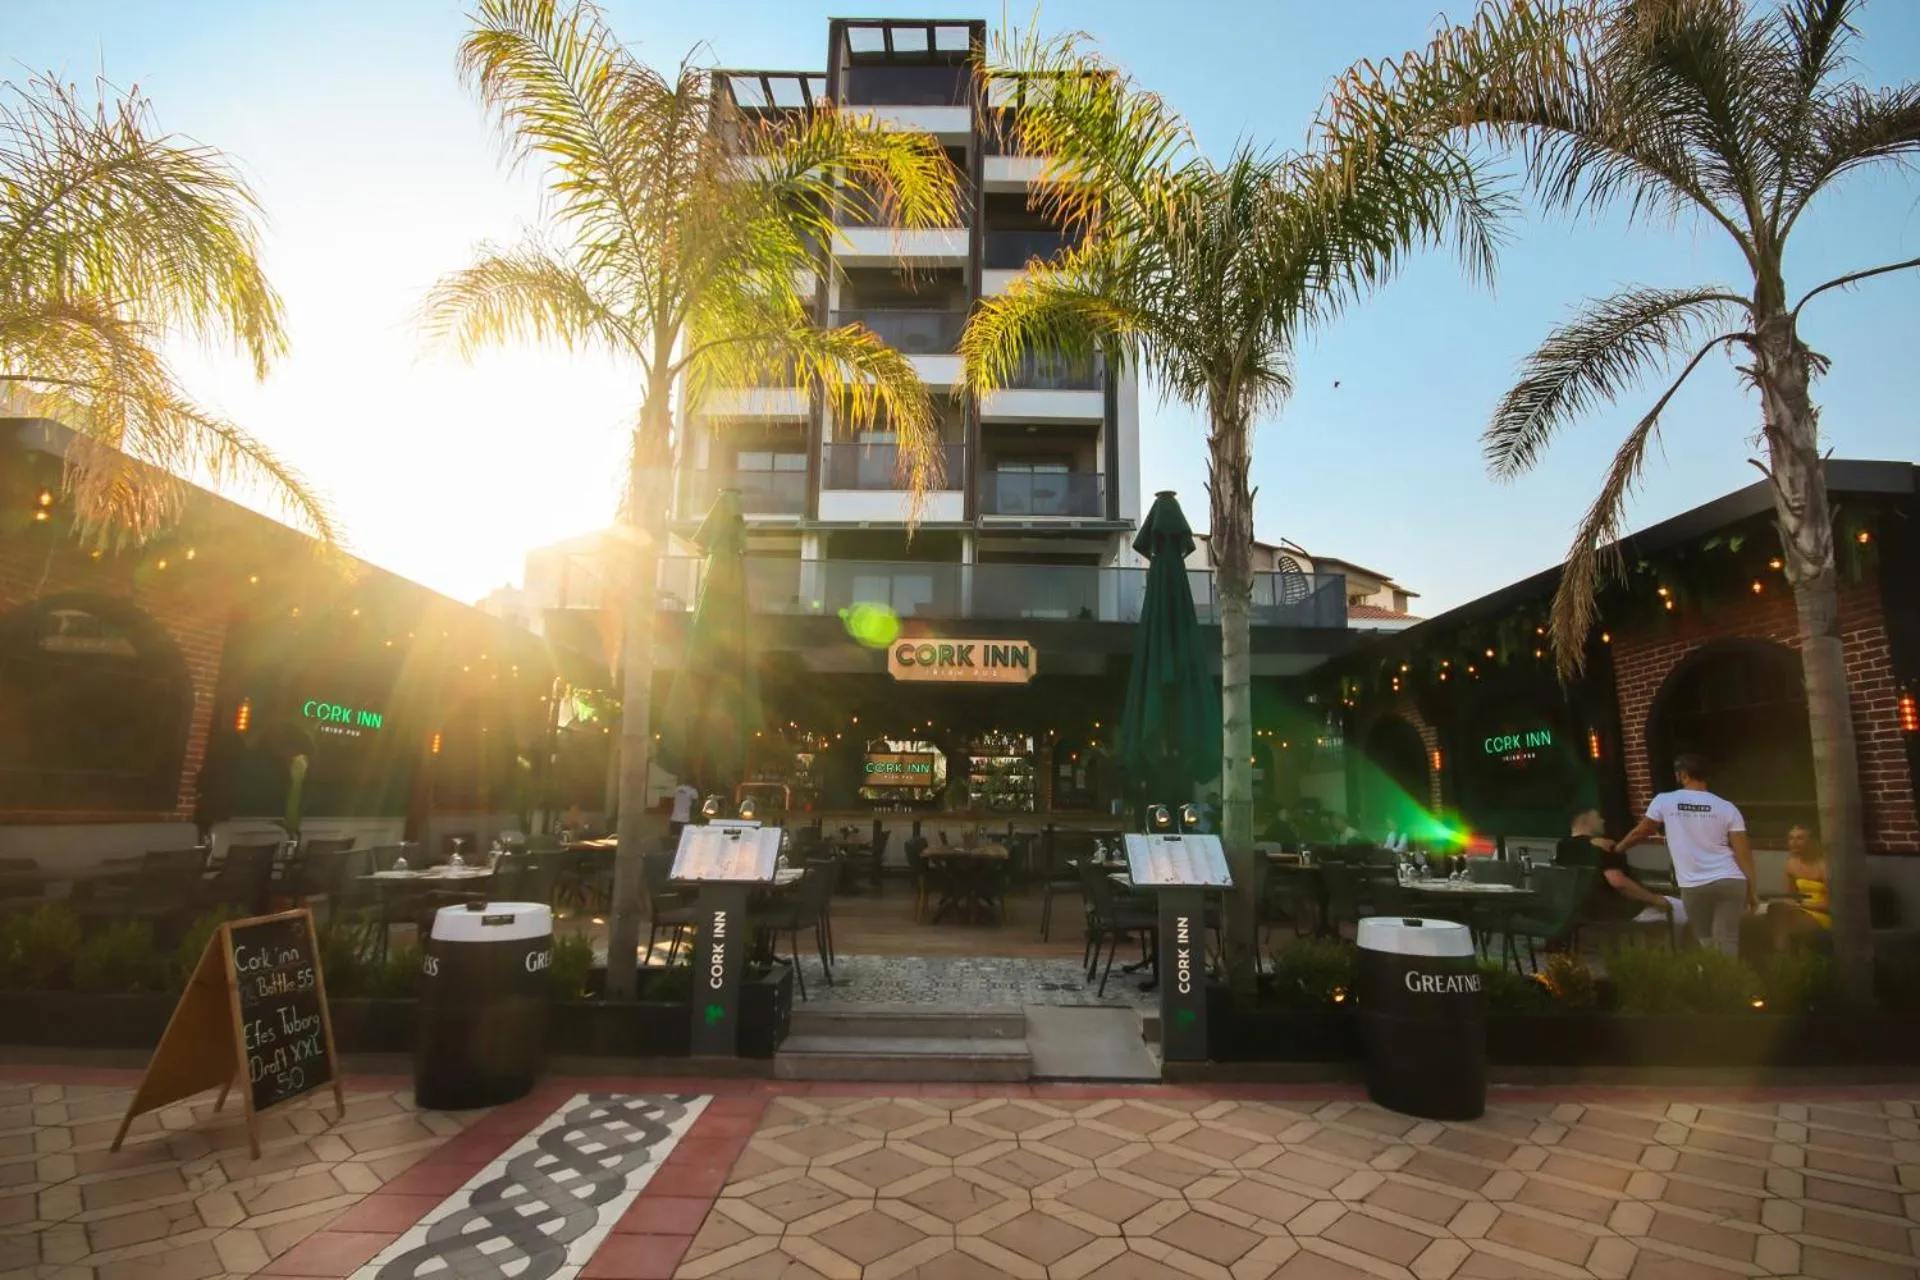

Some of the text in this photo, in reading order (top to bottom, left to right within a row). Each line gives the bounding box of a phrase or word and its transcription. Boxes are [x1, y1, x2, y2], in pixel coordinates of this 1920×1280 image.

[895, 643, 1029, 668] CORK INN
[303, 700, 383, 729] CORK INN
[1484, 729, 1551, 754] CORK INN
[865, 762, 930, 773] CORK INN
[710, 911, 727, 989] CORK INN
[1177, 917, 1191, 994] CORK INN
[256, 967, 314, 997] Bottle 55
[243, 1005, 321, 1050] Efes Tuborg
[289, 1035, 324, 1064] XXL
